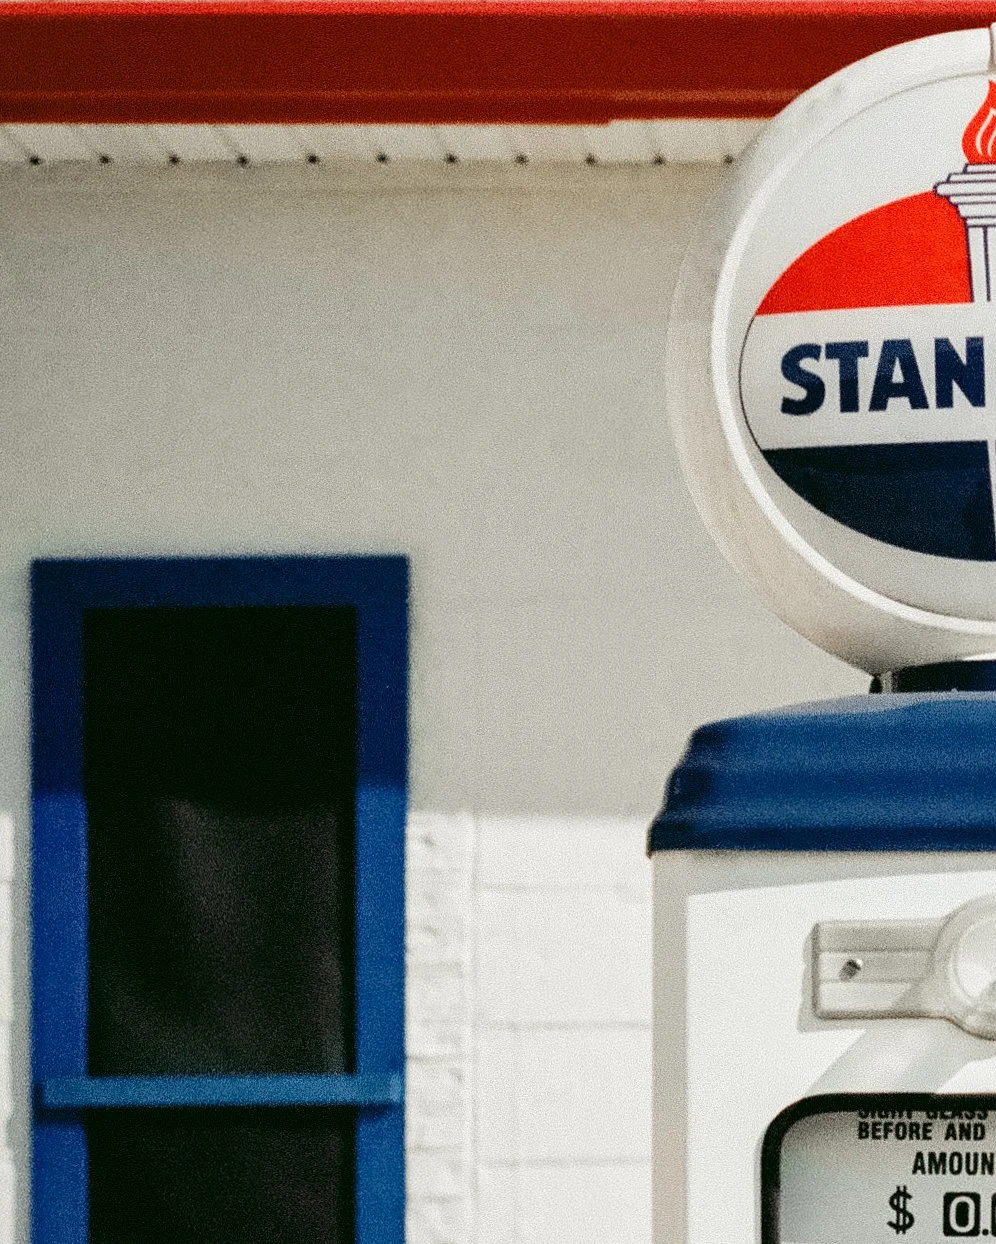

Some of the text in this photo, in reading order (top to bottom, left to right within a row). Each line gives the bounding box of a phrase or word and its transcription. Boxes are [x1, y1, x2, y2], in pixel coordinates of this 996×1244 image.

[858, 1122, 932, 1140] BEFORE
[945, 1123, 985, 1140] AND
[888, 1186, 914, 1234] $
